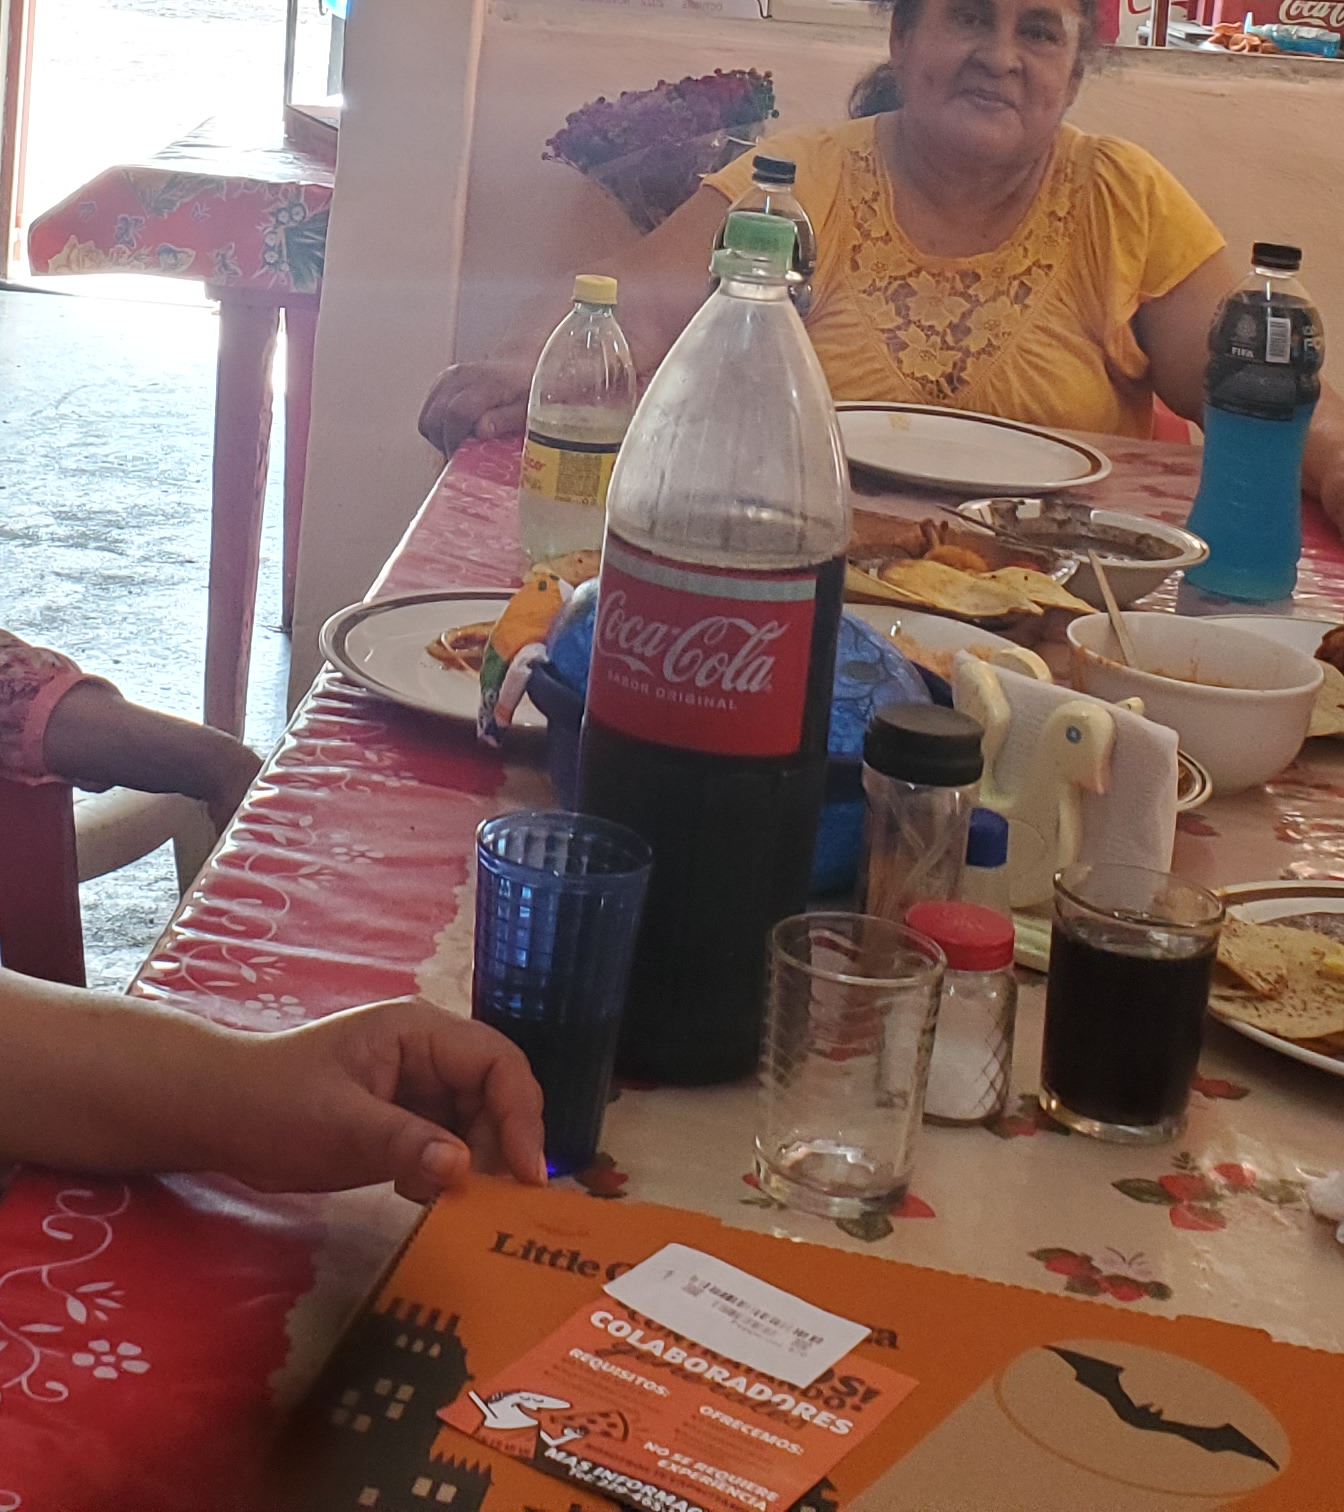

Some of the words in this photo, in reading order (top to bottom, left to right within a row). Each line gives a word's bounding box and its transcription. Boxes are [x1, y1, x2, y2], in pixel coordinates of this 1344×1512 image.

[1231, 346, 1255, 359] FIFA
[596, 588, 790, 695] Coca-Cola
[607, 669, 650, 696] SABOR
[656, 687, 738, 712] ORIGINAL
[487, 1229, 601, 1279] Little
[589, 1310, 854, 1436] COLABORADORES
[643, 1439, 670, 1457] NO
